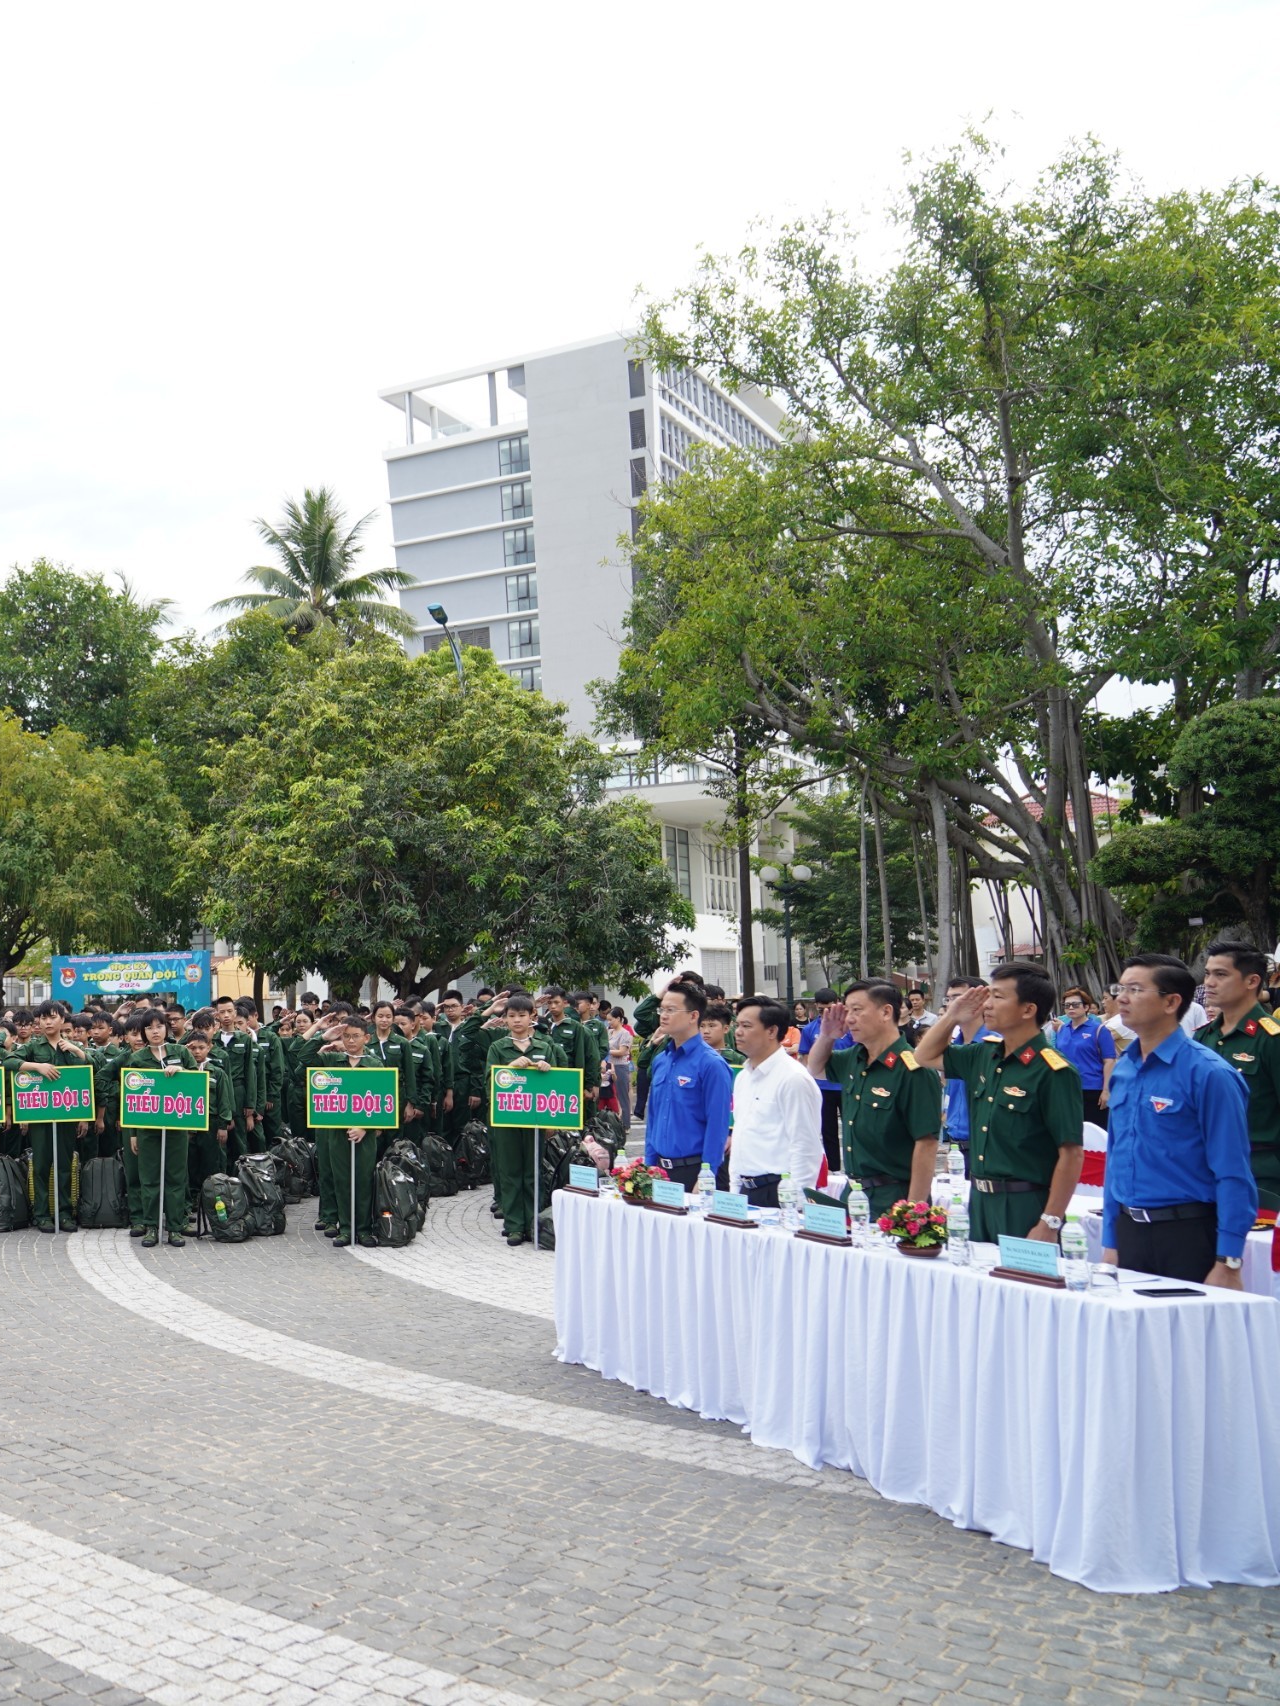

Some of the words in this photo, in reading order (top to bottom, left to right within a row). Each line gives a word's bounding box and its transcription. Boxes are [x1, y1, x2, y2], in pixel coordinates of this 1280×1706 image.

[83, 972, 121, 982] TRONG
[124, 970, 153, 982] QUÂN
[156, 969, 178, 980] ĐỘI
[17, 1085, 49, 1109] TIỂU
[52, 1087, 79, 1111] ĐỘI
[82, 1089, 91, 1106] 5
[126, 1088, 160, 1113] TIỂU
[164, 1092, 192, 1118] ĐỘI
[195, 1097, 204, 1115] 4
[313, 1087, 348, 1113] TIỂU
[352, 1090, 381, 1117] ĐỘI
[385, 1094, 394, 1113] 3
[496, 1086, 532, 1112] TIỂU
[536, 1090, 565, 1117] ĐỘI
[569, 1095, 578, 1114] 2
